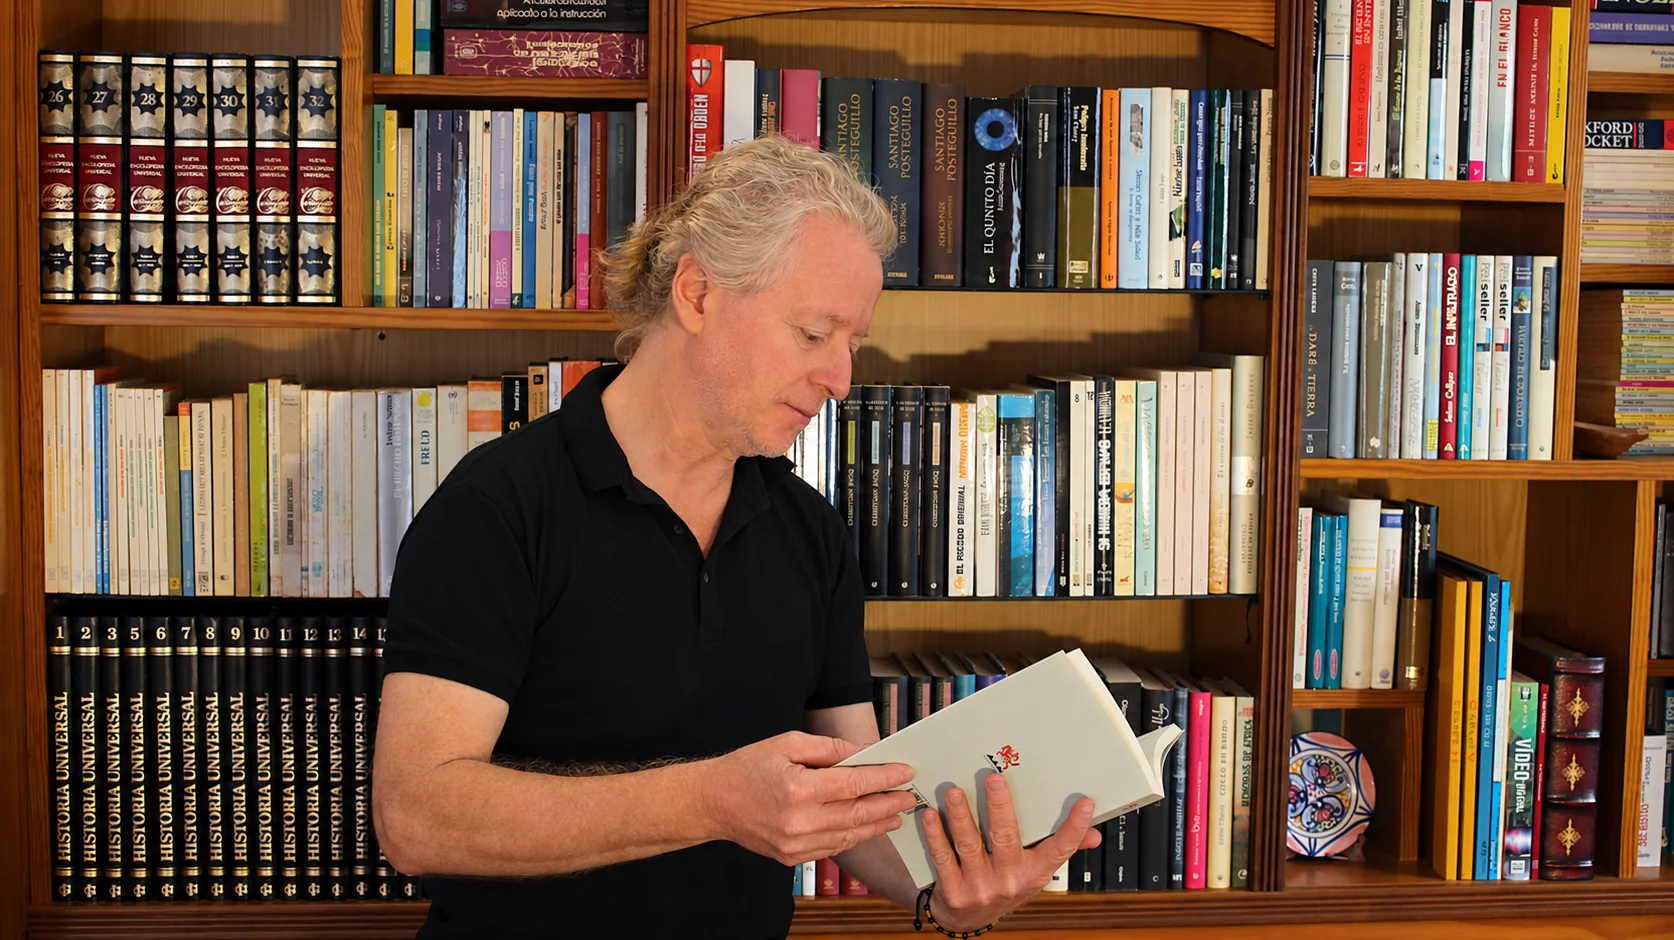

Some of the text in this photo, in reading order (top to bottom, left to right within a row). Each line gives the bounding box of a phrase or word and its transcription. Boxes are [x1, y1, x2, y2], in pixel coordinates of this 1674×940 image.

[48, 90, 64, 103] 26
[92, 91, 109, 104] 27
[140, 93, 157, 106] 28
[182, 95, 198, 107] 29
[220, 95, 239, 108] 30
[309, 95, 325, 108] 32
[837, 103, 848, 160] ANTIAGO
[850, 93, 861, 172] OSTEGUILLO
[1585, 121, 1633, 134] XFORD
[888, 105, 899, 169] SANTIAGO
[901, 96, 912, 179] POSTEGUILLO
[935, 107, 945, 171] SANTIAGO
[947, 98, 958, 181] POSTEGUILLO
[1585, 135, 1633, 148] OCKET
[984, 162, 995, 184] DÍA
[984, 242, 995, 254] EL
[1480, 283, 1489, 321] seller
[1499, 283, 1509, 321] seller
[56, 626, 65, 639] 1
[81, 627, 91, 640] 2
[107, 627, 117, 640] 3
[130, 628, 140, 640] 5
[156, 627, 166, 640] 6
[181, 626, 191, 640] 7
[205, 627, 215, 640] 8
[230, 627, 241, 640] 9
[253, 627, 269, 640] 10
[280, 628, 292, 641] 11
[304, 628, 318, 641] 12
[328, 628, 342, 641] 13
[353, 628, 367, 640] 14
[55, 692, 71, 862] HISTORIA UNIVERSAL
[81, 692, 96, 862] HISTORIA UNIVERSAL
[106, 692, 121, 862] HISTORIA UNIVERSAL
[130, 692, 146, 862] HISTORIA UNIVERSAL
[157, 692, 173, 862] HISTORIA UNIVERSAL
[181, 692, 198, 862] HISTORIA UNIVERSAL
[206, 692, 223, 862] HISTORIA UNIVERSAL
[230, 692, 248, 862] HISTORIA UNIVERSAL
[256, 692, 272, 862] HISTORIA UNIVERSAL
[281, 692, 296, 862] HISTORIA UNIVERSAL
[305, 692, 319, 862] HISTORIA UNIVERSAL
[329, 692, 343, 862] HISTORIA UNIVERSAL
[354, 692, 368, 862] HISTORIA UNIVERSAL
